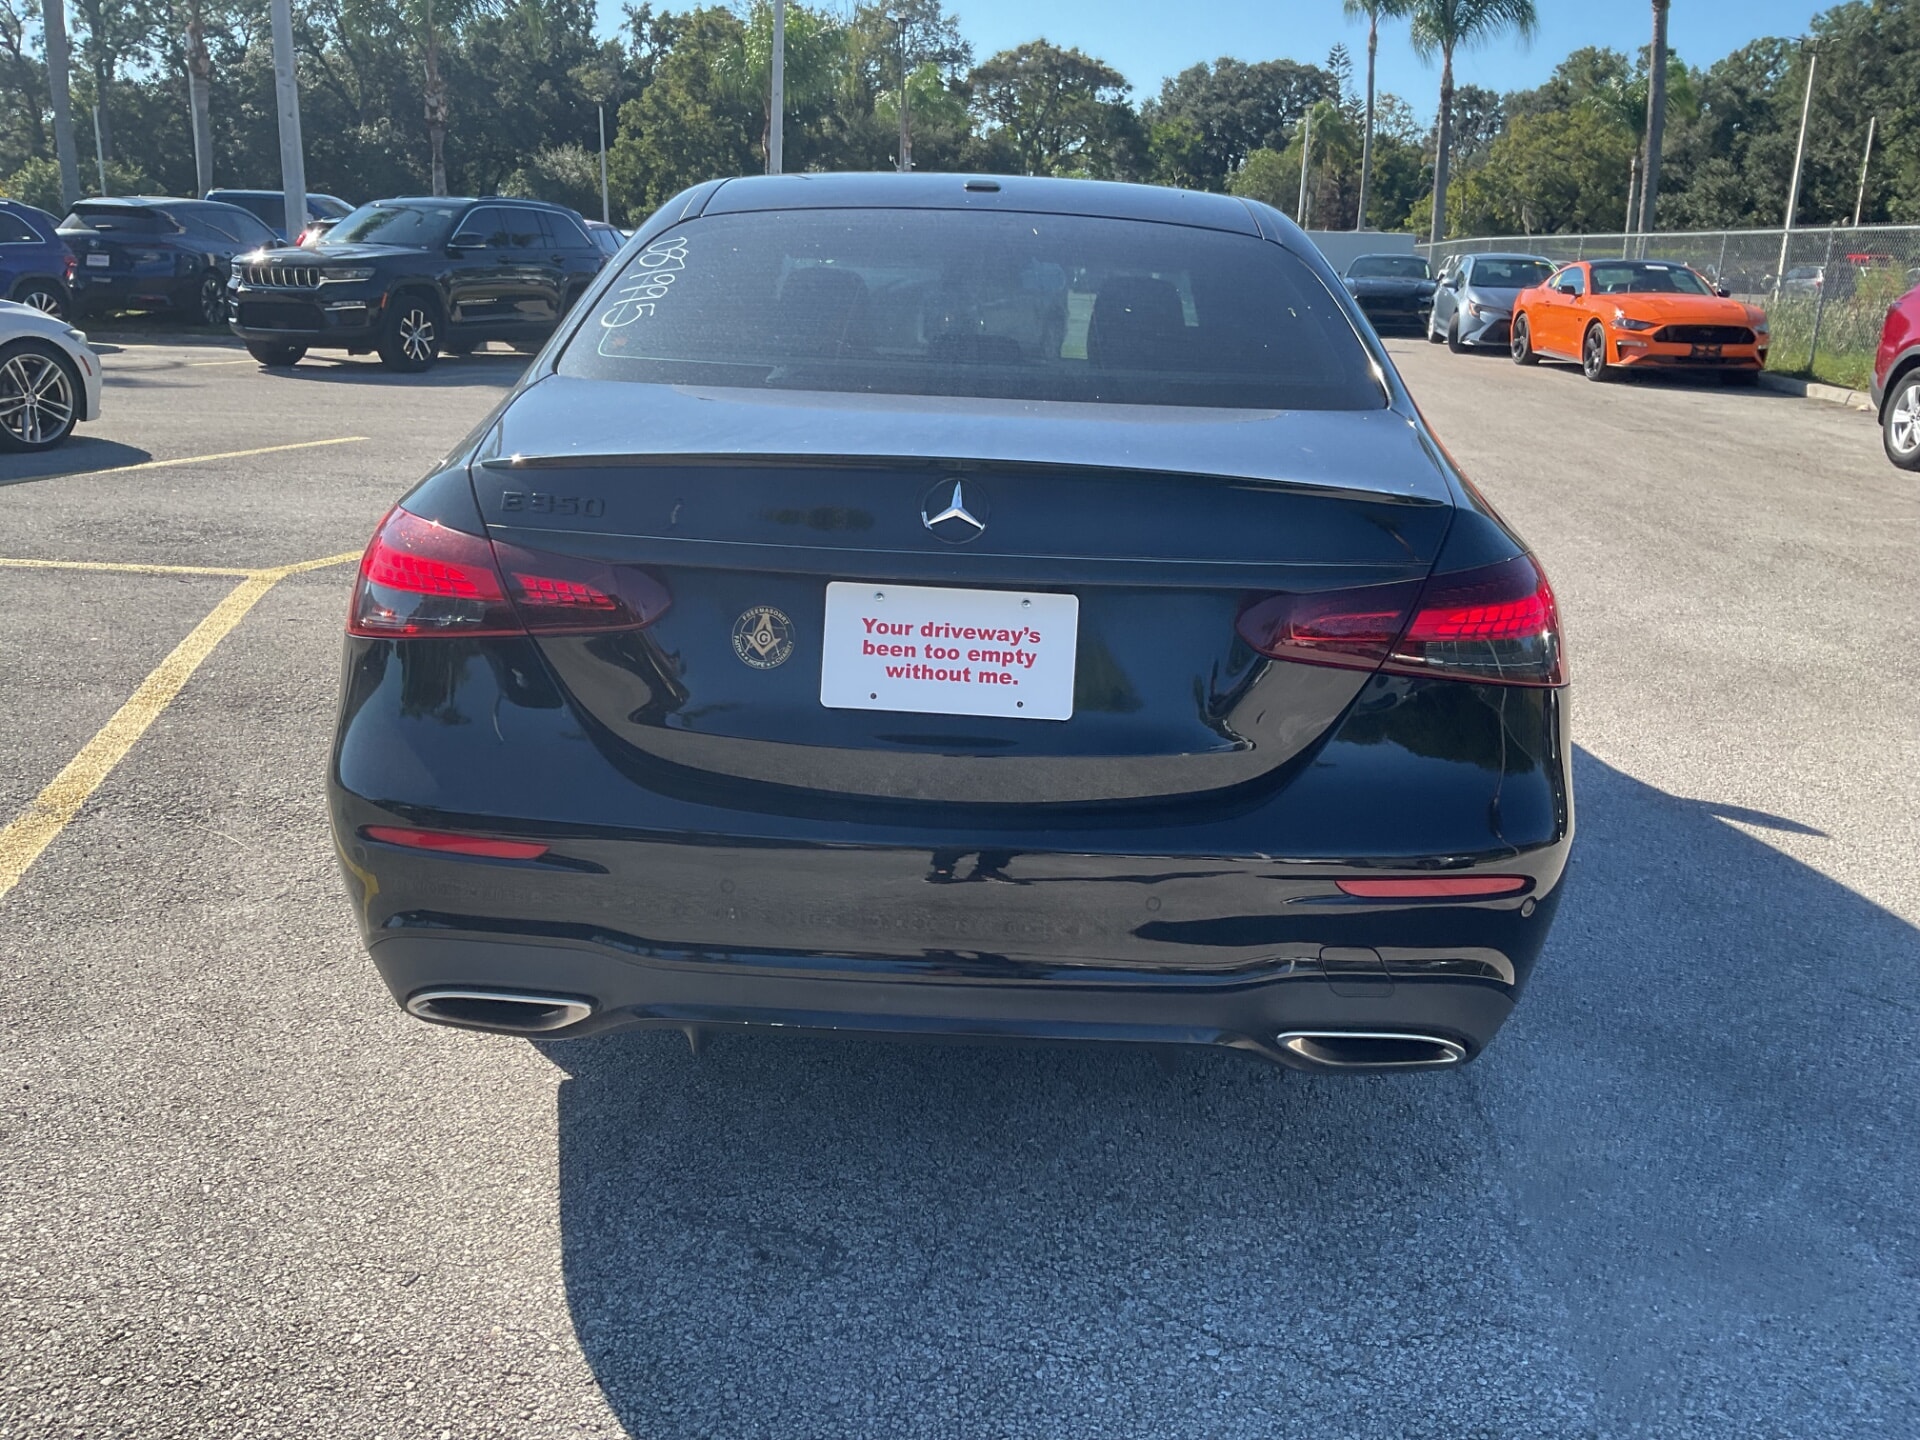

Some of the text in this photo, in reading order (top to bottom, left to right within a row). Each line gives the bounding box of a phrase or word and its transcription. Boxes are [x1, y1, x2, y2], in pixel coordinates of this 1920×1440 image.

[742, 607, 790, 625] FREEMASONRY
[861, 617, 914, 636] Your
[733, 635, 793, 668] FAITH HOPE CHARITY
[862, 639, 1037, 669] been too empty
[885, 663, 1019, 685] without me.
